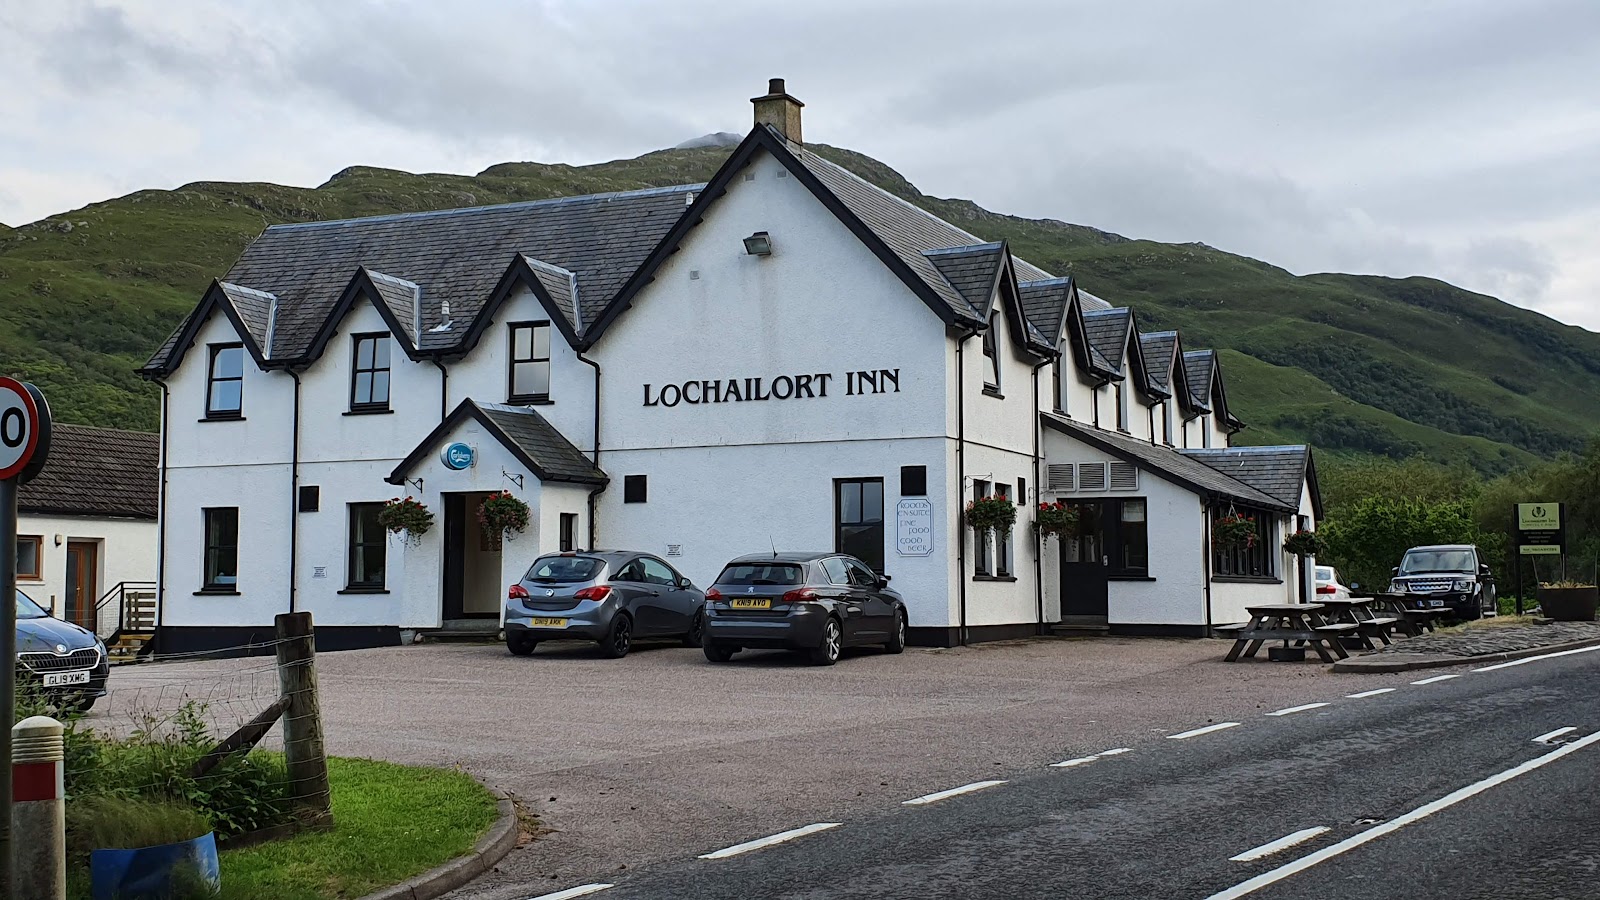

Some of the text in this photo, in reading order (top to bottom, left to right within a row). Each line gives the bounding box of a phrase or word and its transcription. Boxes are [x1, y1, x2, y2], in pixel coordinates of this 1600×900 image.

[642, 368, 900, 408] LOCHAILORT INN
[0, 406, 26, 448] 0
[908, 527, 930, 535] FOOD
[900, 537, 923, 545] GOOD
[49, 674, 68, 685] GL19
